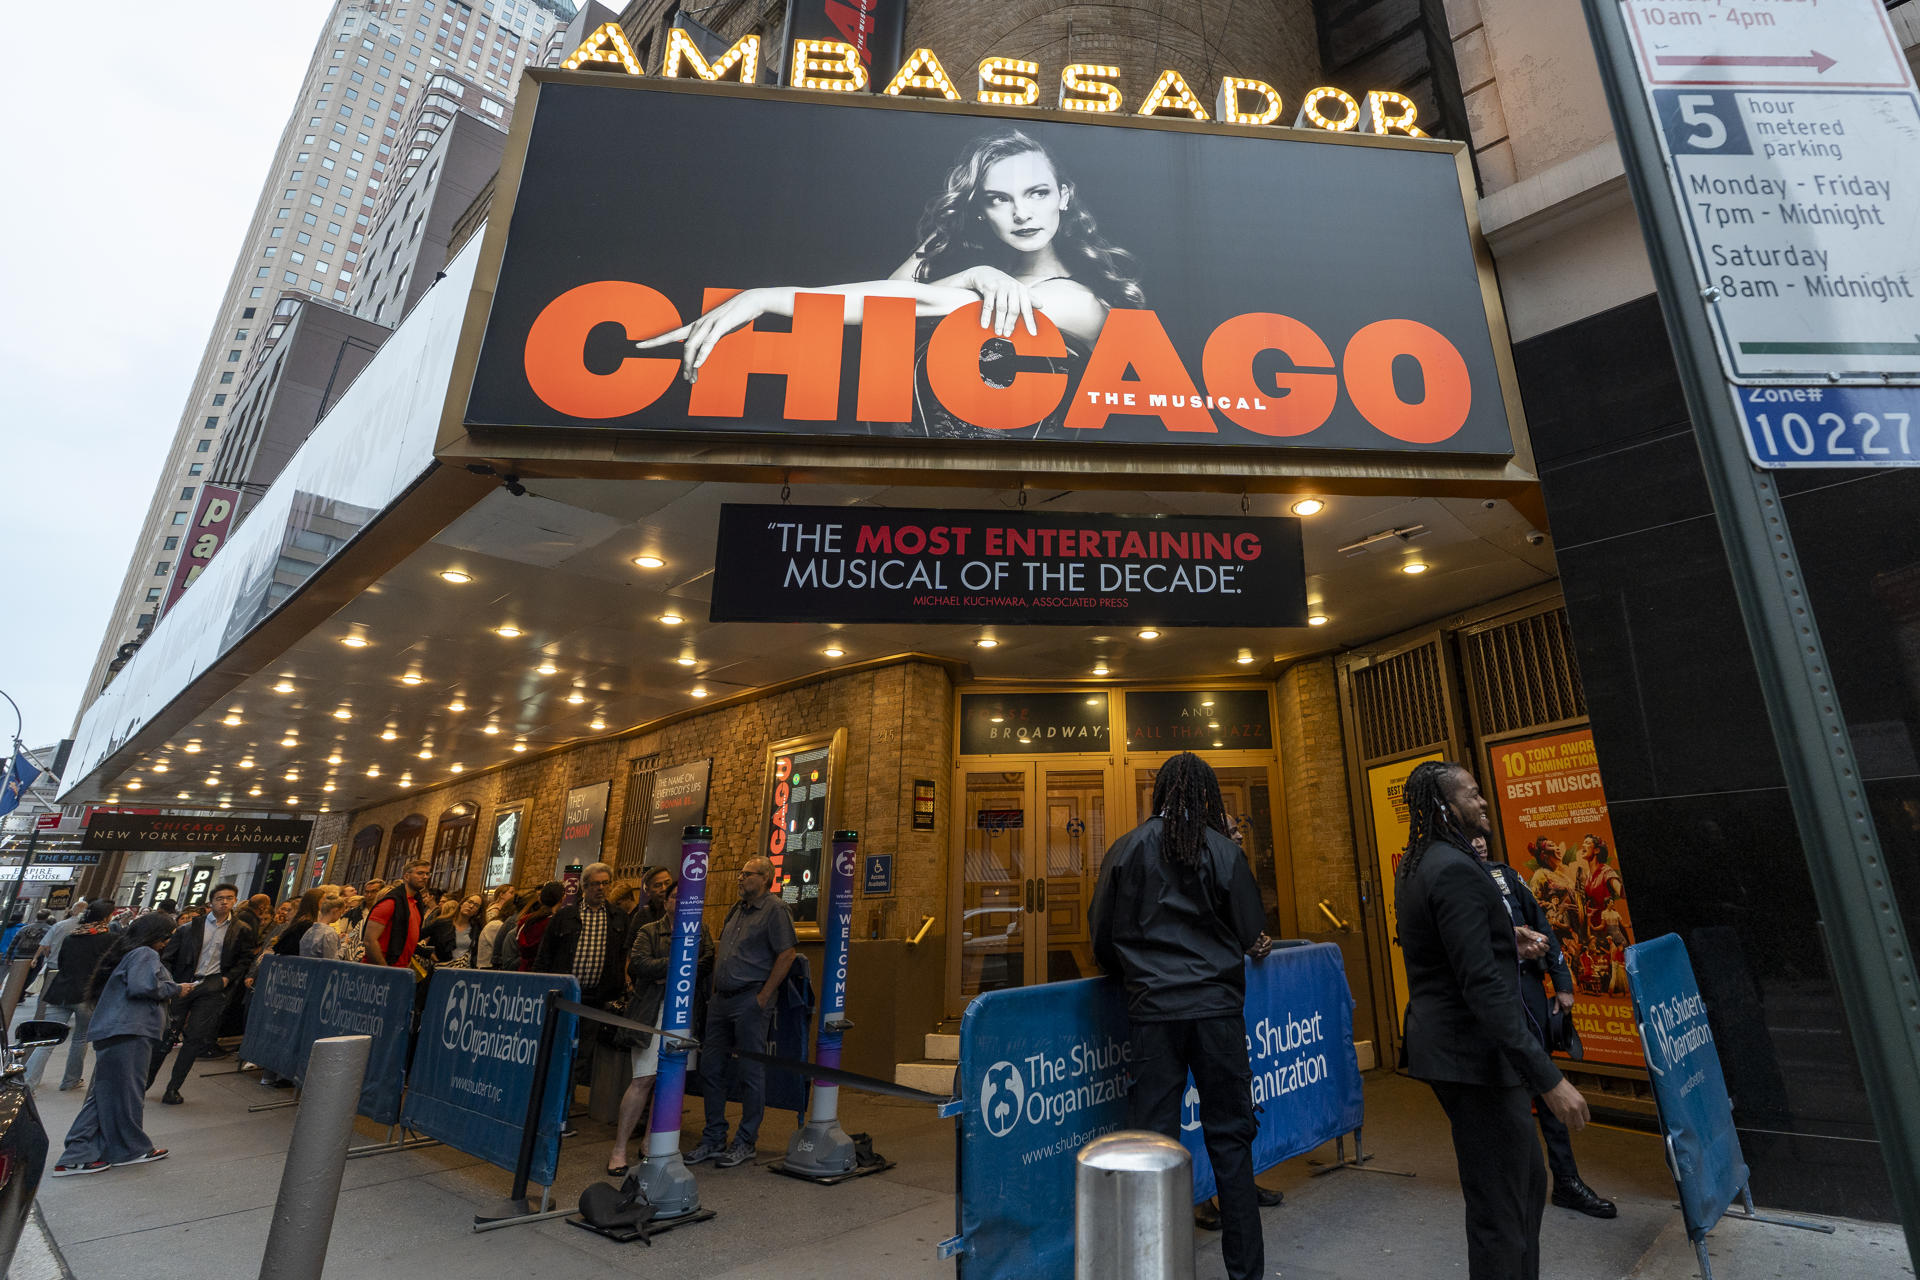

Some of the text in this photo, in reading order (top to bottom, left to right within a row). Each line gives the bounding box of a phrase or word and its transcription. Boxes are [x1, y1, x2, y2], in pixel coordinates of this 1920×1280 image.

[1641, 8, 1702, 26] 10am
[1726, 8, 1776, 29] 4pm
[559, 22, 1430, 139] AMBASSADOR
[1748, 97, 1795, 115] hour
[1677, 94, 1728, 149] 5
[1756, 119, 1845, 137] metered
[1763, 139, 1842, 161] parking
[1690, 174, 1787, 200] Monday
[1813, 174, 1891, 200] Friday
[1699, 203, 1754, 229] 7pm
[1780, 203, 1885, 230] Midnight
[1711, 244, 1829, 271] Saturday
[1720, 275, 1779, 299] 8am
[1803, 275, 1913, 303] Midnight
[524, 279, 1472, 444] CHICAGO
[1087, 390, 1268, 411] THE MUSICAL
[1749, 388, 1823, 403] Zone#
[1755, 411, 1911, 456] 10227
[855, 525, 972, 556] MOST
[985, 528, 1262, 562] ENTERTAINING
[783, 558, 948, 591] MUSICAL
[960, 560, 1009, 591] OF
[1022, 562, 1085, 593] THE
[913, 595, 1129, 609] MICHAEL KUCHWARA, ASSOCIATED PRESS
[1181, 707, 1215, 718] AND
[1134, 727, 1161, 739] ALL
[1502, 739, 1595, 778] 10 TONY AWAR
[1528, 752, 1598, 775] NOMINATION
[1386, 785, 1401, 796] BEST
[1506, 772, 1602, 800] BEST MUSICA
[566, 808, 590, 825] HAD IT
[1538, 804, 1556, 812] MOST
[1569, 807, 1599, 817] MUSICAL
[93, 830, 130, 839] NEW
[138, 831, 178, 840] YORK
[186, 832, 219, 841] CITY
[769, 757, 792, 893] HICAGO
[1524, 821, 1538, 829] THE
[1538, 817, 1572, 828] BROADWAY
[14, 867, 54, 875] EPIRE
[62, 854, 98, 862] PEARL
[675, 920, 700, 1025] WELCOME
[834, 913, 852, 1008] WELCOME
[339, 972, 391, 1007] The Shubert
[469, 982, 545, 1026] The Shubert
[1601, 1004, 1634, 1019] VIS
[1671, 991, 1705, 1025] Shubert
[332, 1001, 384, 1040] Organization
[461, 1019, 538, 1066] Organization
[1255, 1010, 1324, 1060] Shubert
[1024, 1036, 1132, 1089] The Shube
[1250, 1050, 1328, 1110] anization
[1026, 1067, 1129, 1126] Organizati
